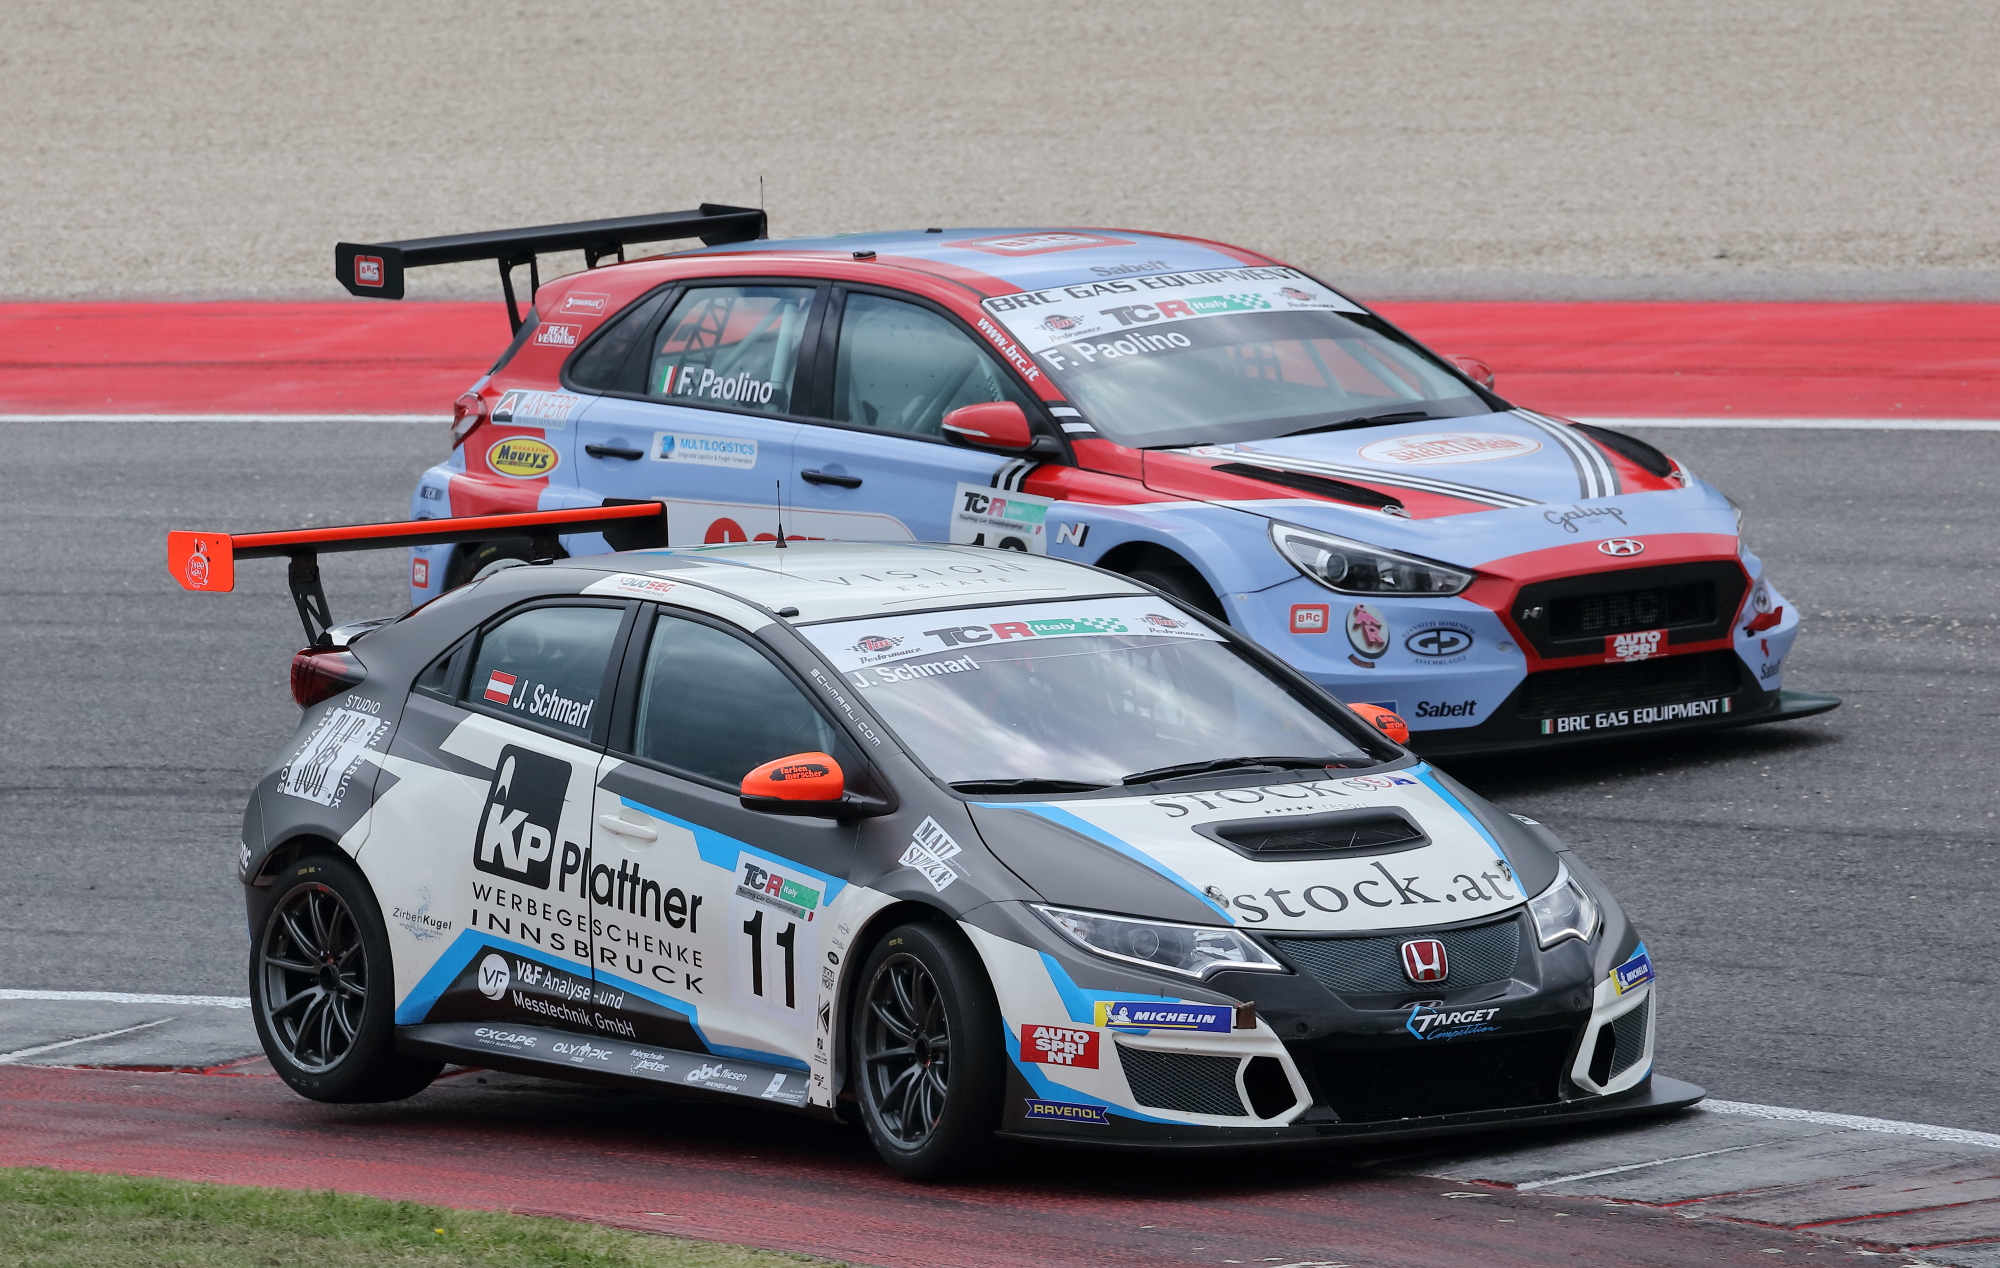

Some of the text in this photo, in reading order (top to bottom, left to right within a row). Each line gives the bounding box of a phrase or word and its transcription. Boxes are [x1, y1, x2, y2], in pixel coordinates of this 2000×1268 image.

[995, 233, 1079, 248] BRC
[361, 265, 378, 275] BRC
[1090, 260, 1173, 277] Sabelt
[986, 267, 1301, 312] BRC GAS EQUIPMENT
[1100, 299, 1228, 326] TCR Italy
[537, 333, 576, 345] VENDING
[547, 325, 569, 336] REAL
[1049, 325, 1102, 343] Performance
[977, 317, 1040, 382] www.brc.it
[1040, 331, 1192, 371] F. Paolino
[677, 366, 773, 404] F. Paolino
[680, 438, 755, 456] MULTILOGISTICS
[964, 491, 1007, 518] TCR
[959, 514, 978, 523] Touring
[819, 563, 1029, 587] VISION
[896, 577, 1013, 592] ESTATE
[1298, 612, 1321, 623] BRC
[923, 621, 1077, 647] TCR Italy
[1613, 631, 1661, 647] AUTO
[858, 647, 922, 665] Performance
[1616, 642, 1657, 657] SPRI
[852, 654, 981, 689] J. Schmarl
[345, 694, 381, 714] STUDIO
[512, 679, 594, 728] J. Schmarl
[1415, 700, 1477, 718] Sabelt
[1558, 699, 1718, 733] BRC GAS EQUIPMENT
[780, 765, 808, 774] farben
[785, 771, 823, 780] morscher
[1150, 781, 1353, 818] STOCK
[916, 820, 956, 860] MAIL
[479, 802, 703, 933] KP Plattner
[743, 862, 798, 898] TCR Italy
[738, 886, 756, 899] Touring
[765, 897, 798, 914] Championship
[1232, 861, 1515, 923] stock.at
[393, 907, 452, 930] ZirbenKugel
[472, 881, 703, 969] WERBEGESCHENKE
[471, 908, 704, 994] INNSBRUCK
[743, 909, 796, 1009] 11
[516, 960, 543, 986] V&F
[542, 970, 591, 1000] Analyse
[1626, 963, 1648, 982] MICHELIN
[513, 989, 636, 1038] Messtechnik GmbH
[1134, 1011, 1216, 1024] MICHELIN
[1414, 1007, 1500, 1032] TARGET
[1032, 1026, 1090, 1044] AUTO
[1427, 1023, 1501, 1041] Competition
[552, 1042, 613, 1061] OLYMPIC
[1035, 1038, 1084, 1055] SPRI
[1047, 1051, 1075, 1064] NT
[1034, 1104, 1100, 1119] RAVENOL
